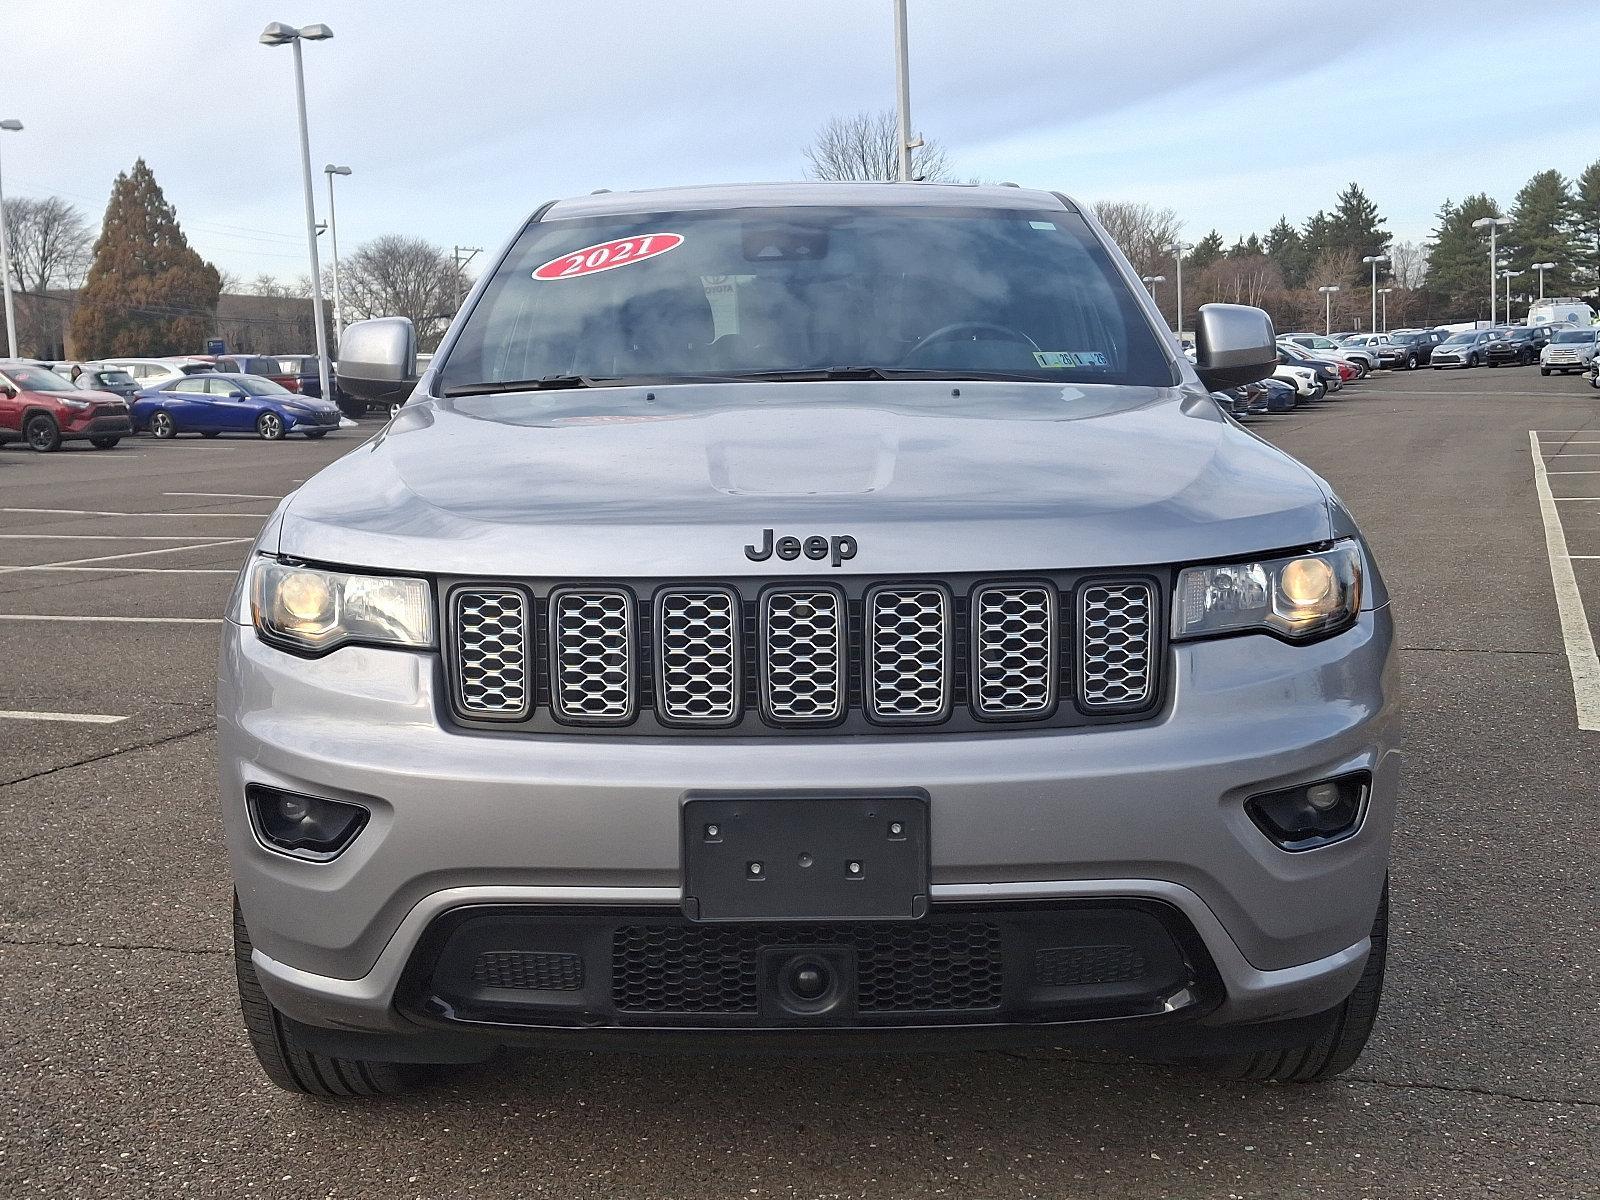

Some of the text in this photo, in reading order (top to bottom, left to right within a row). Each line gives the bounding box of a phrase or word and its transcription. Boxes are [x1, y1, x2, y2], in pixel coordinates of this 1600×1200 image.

[559, 236, 655, 277] 2021
[705, 285, 735, 295] OYOTA
[744, 528, 858, 568] Jeep
